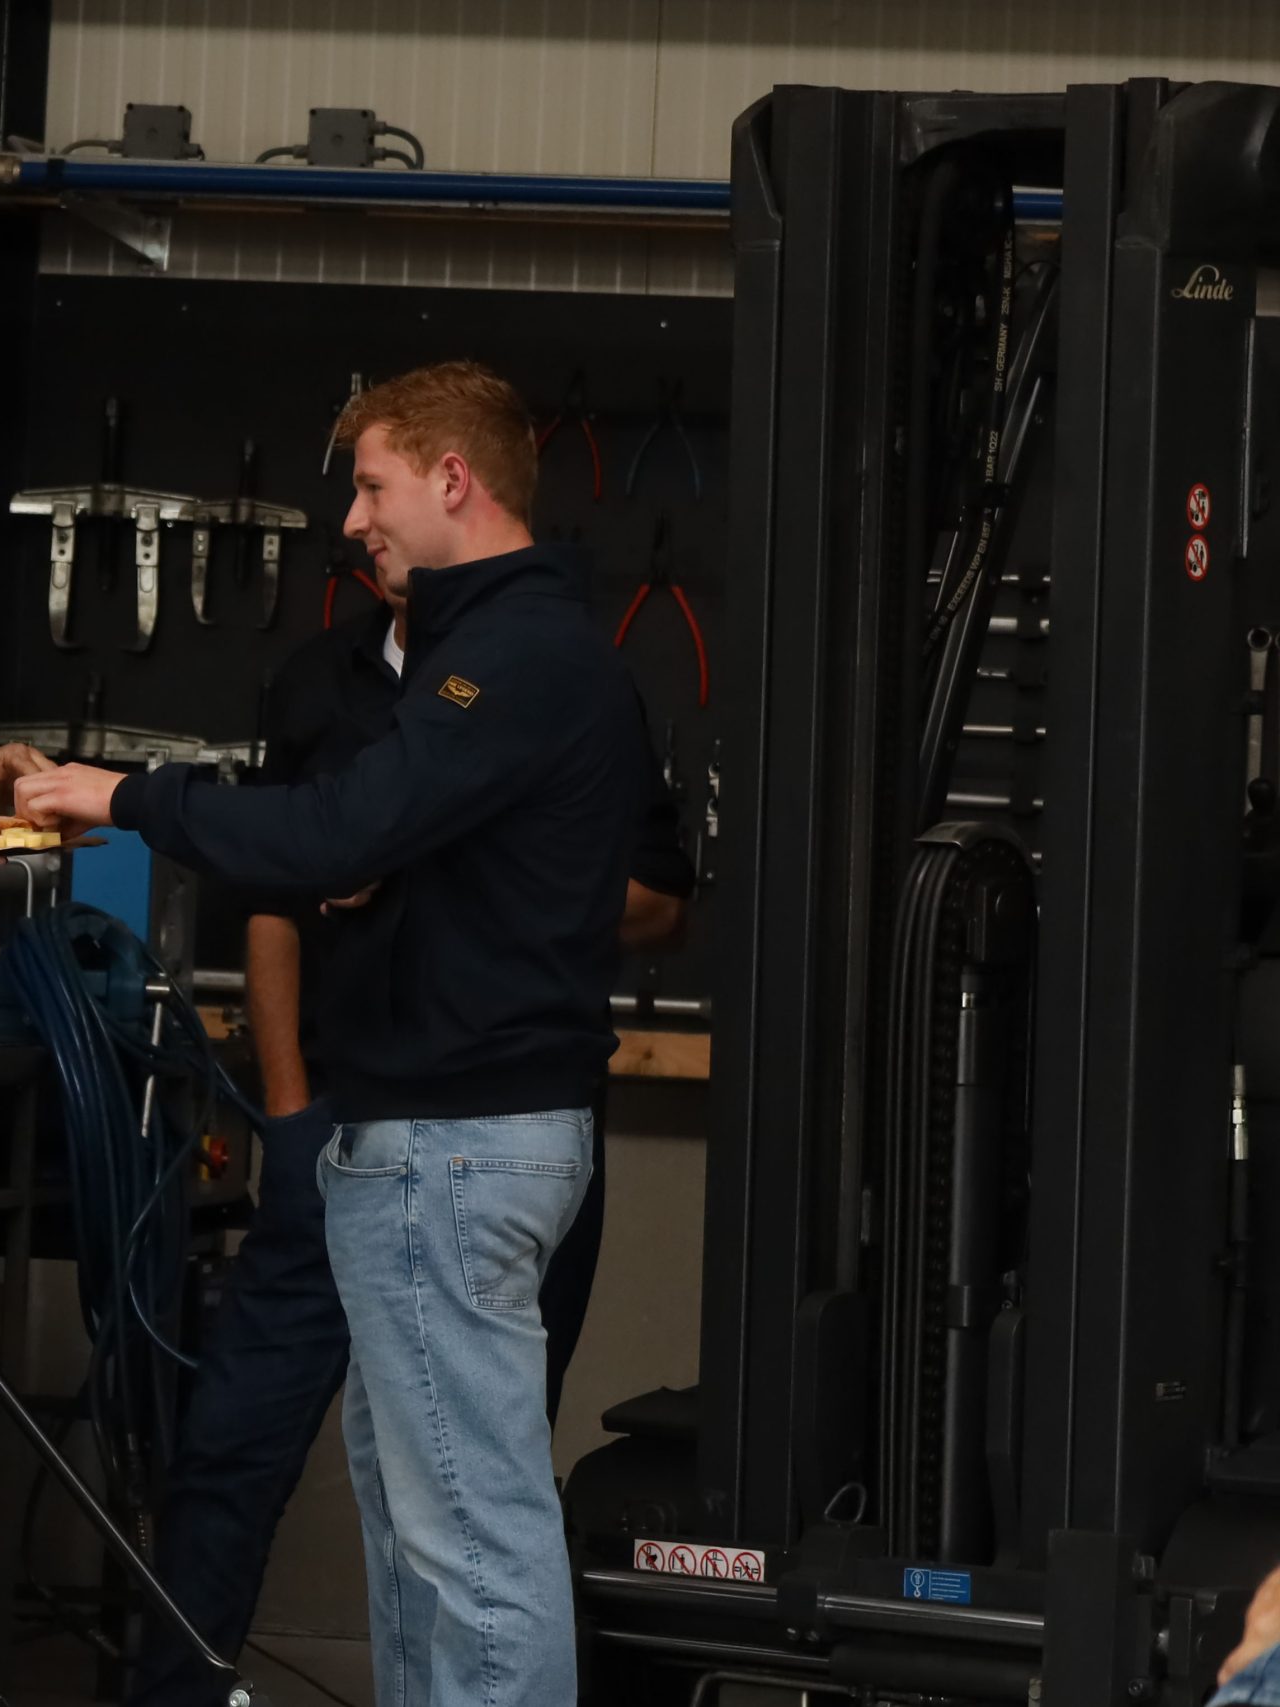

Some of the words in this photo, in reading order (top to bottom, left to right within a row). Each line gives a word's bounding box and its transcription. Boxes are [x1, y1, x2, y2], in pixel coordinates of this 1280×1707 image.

[1171, 264, 1234, 300] Linde
[996, 323, 1008, 371] GERMANY
[989, 431, 999, 453] 1Q22
[986, 456, 995, 479] BAR
[947, 570, 975, 611] EXCEEDS
[977, 539, 988, 554] EN
